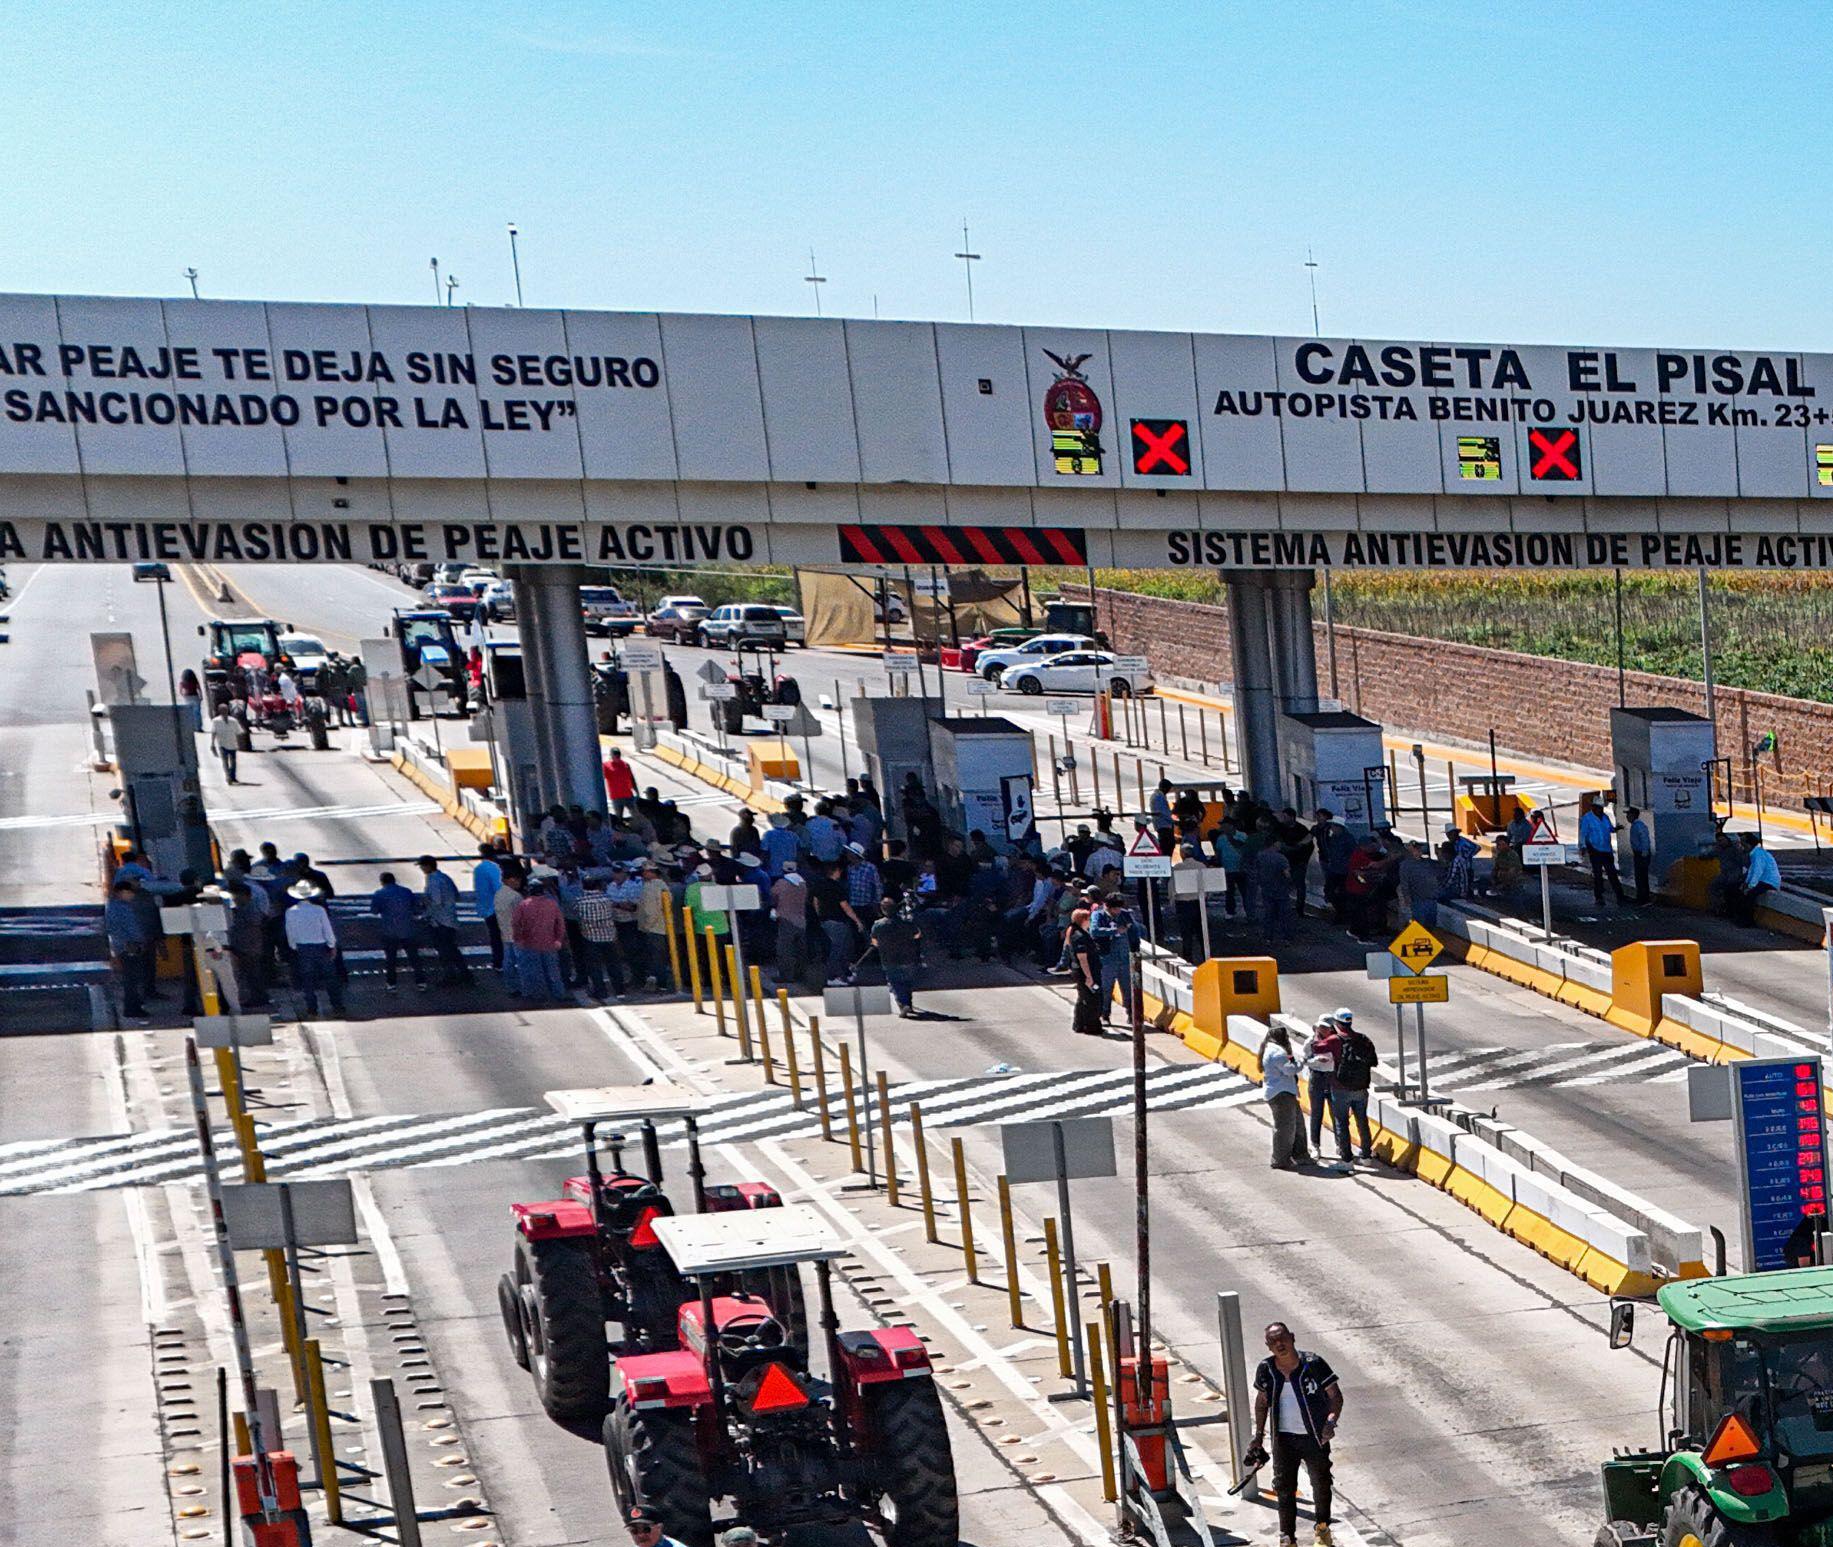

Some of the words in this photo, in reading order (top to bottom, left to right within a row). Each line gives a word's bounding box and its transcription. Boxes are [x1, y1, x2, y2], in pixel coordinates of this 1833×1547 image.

[59, 344, 202, 379] PEAJE
[212, 349, 270, 380] TE
[284, 350, 395, 383] DEJA
[407, 352, 477, 386] SIN
[492, 355, 659, 388] SEGURO
[1296, 343, 1531, 390] CASETA
[1568, 352, 1636, 392] EL
[1657, 352, 1815, 402] PISAL
[5, 390, 299, 426] SANCIONADO
[314, 396, 403, 427] POR
[415, 398, 469, 429] LA
[1214, 391, 1417, 420] AUTOPISTA
[1429, 397, 1555, 422] BENITO
[1568, 397, 1698, 425] JUAREZ
[1708, 403, 1767, 427] Km.
[43, 522, 352, 560] ANTIEVASION
[369, 523, 427, 560] DE
[443, 524, 581, 561] PEAJE
[599, 522, 753, 560] ACTIVO
[1168, 532, 1330, 564] SISTEMA
[1342, 533, 1572, 566] ANTIEVASION
[1586, 534, 1628, 566] DE
[1642, 535, 1741, 567] PEAJE
